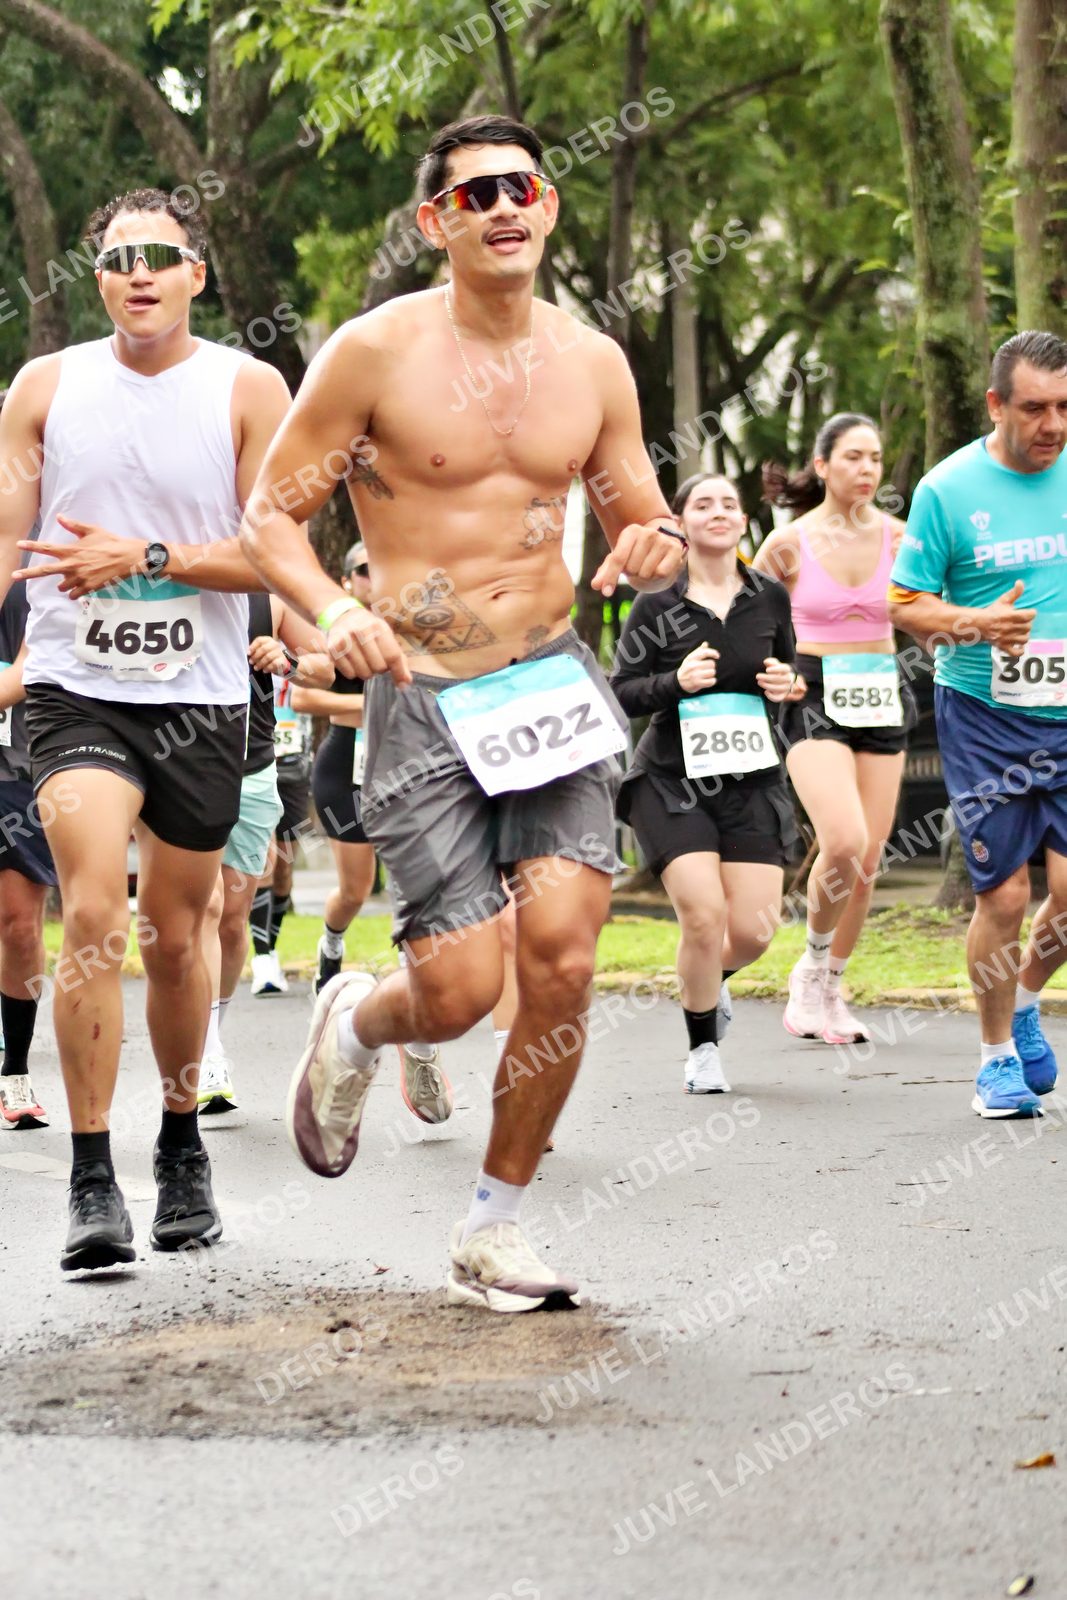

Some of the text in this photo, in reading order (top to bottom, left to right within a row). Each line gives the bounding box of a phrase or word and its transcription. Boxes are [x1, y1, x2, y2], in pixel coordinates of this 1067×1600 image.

[85, 618, 194, 655] 4650
[831, 687, 894, 708] 6582
[477, 702, 603, 767] 6022
[689, 730, 764, 757] 2860
